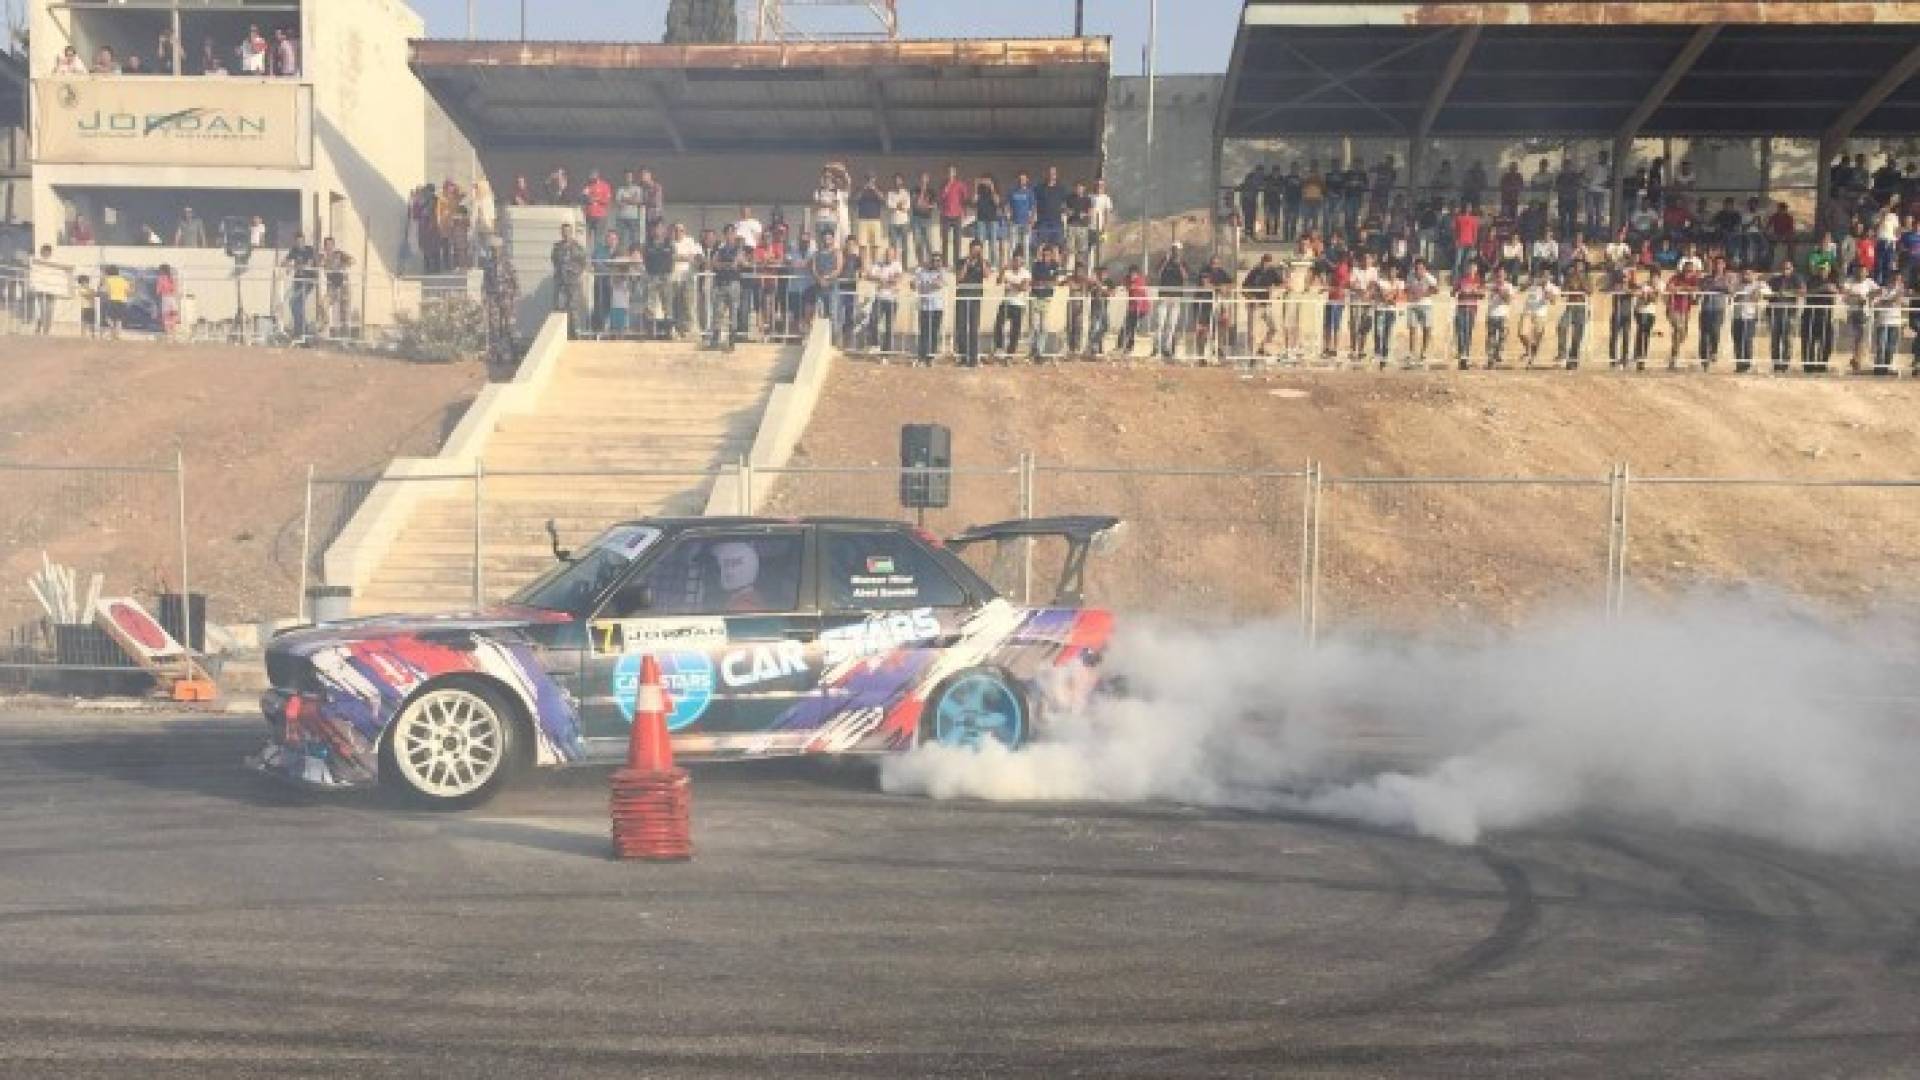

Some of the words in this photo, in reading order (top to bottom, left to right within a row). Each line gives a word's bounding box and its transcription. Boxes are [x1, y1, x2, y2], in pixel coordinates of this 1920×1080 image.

[78, 109, 265, 135] JORDAN
[596, 621, 614, 653] 7
[721, 640, 808, 687] CAR
[820, 607, 941, 664] STARS
